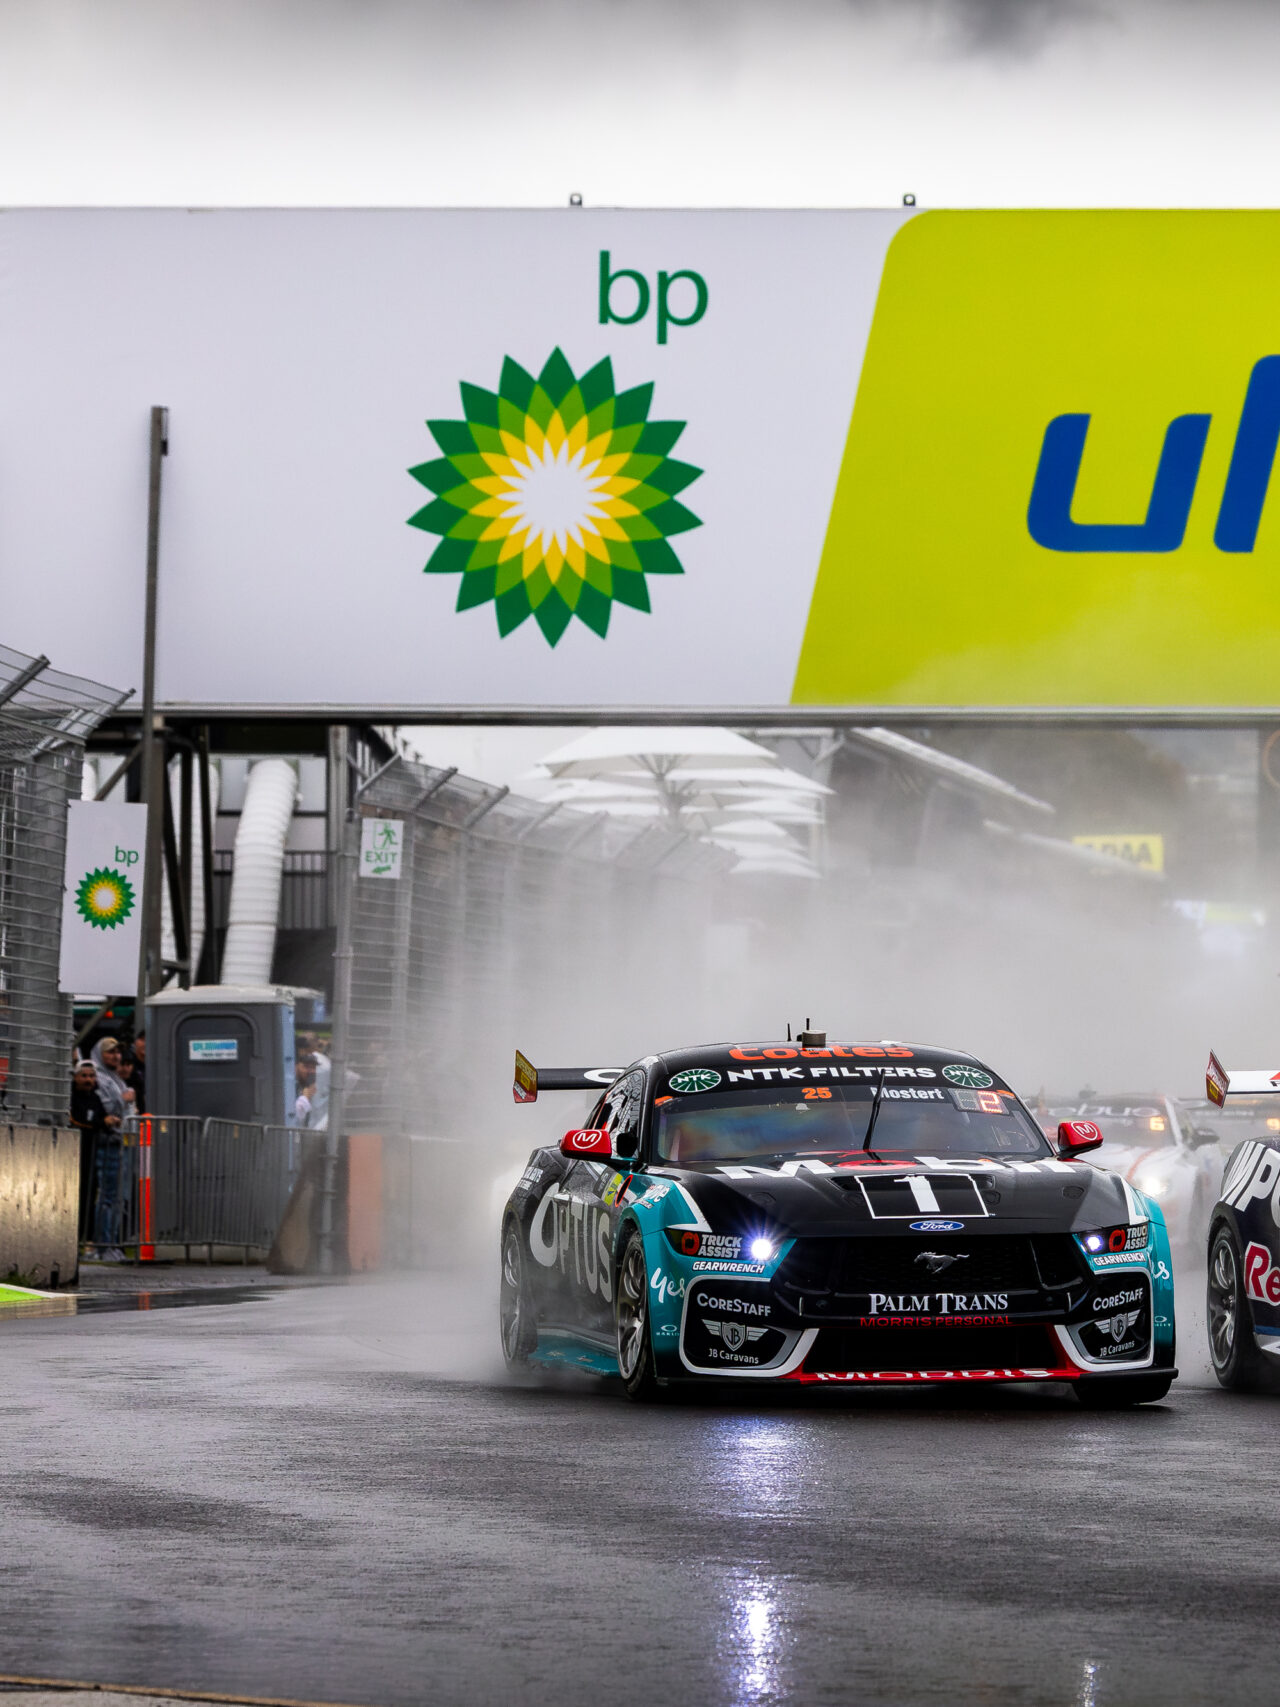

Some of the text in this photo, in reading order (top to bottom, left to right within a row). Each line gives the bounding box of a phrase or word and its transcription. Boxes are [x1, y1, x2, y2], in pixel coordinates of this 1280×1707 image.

[598, 249, 708, 345] bp
[114, 845, 139, 867] bp
[365, 850, 398, 864] EXIT
[728, 1045, 915, 1061] Coates
[677, 1073, 712, 1084] NTK
[727, 1067, 937, 1083] NTK FILTERS
[948, 1069, 982, 1079] NTK
[801, 1087, 833, 1100] 25
[870, 1086, 945, 1100] Mostert
[893, 1175, 941, 1213] 1
[530, 1182, 613, 1303] OPTUS
[700, 1234, 743, 1248] TRUCK
[698, 1245, 741, 1259] ASSIST
[1093, 1252, 1147, 1266] GEARWRENCH
[692, 1261, 765, 1273] GEARWRENCH
[868, 1293, 1009, 1314] PALM TRANS
[860, 1315, 1013, 1327] MORRIS PERSONAL
[1108, 1340, 1135, 1355] Caravans
[708, 1348, 760, 1364] JB Caravans
